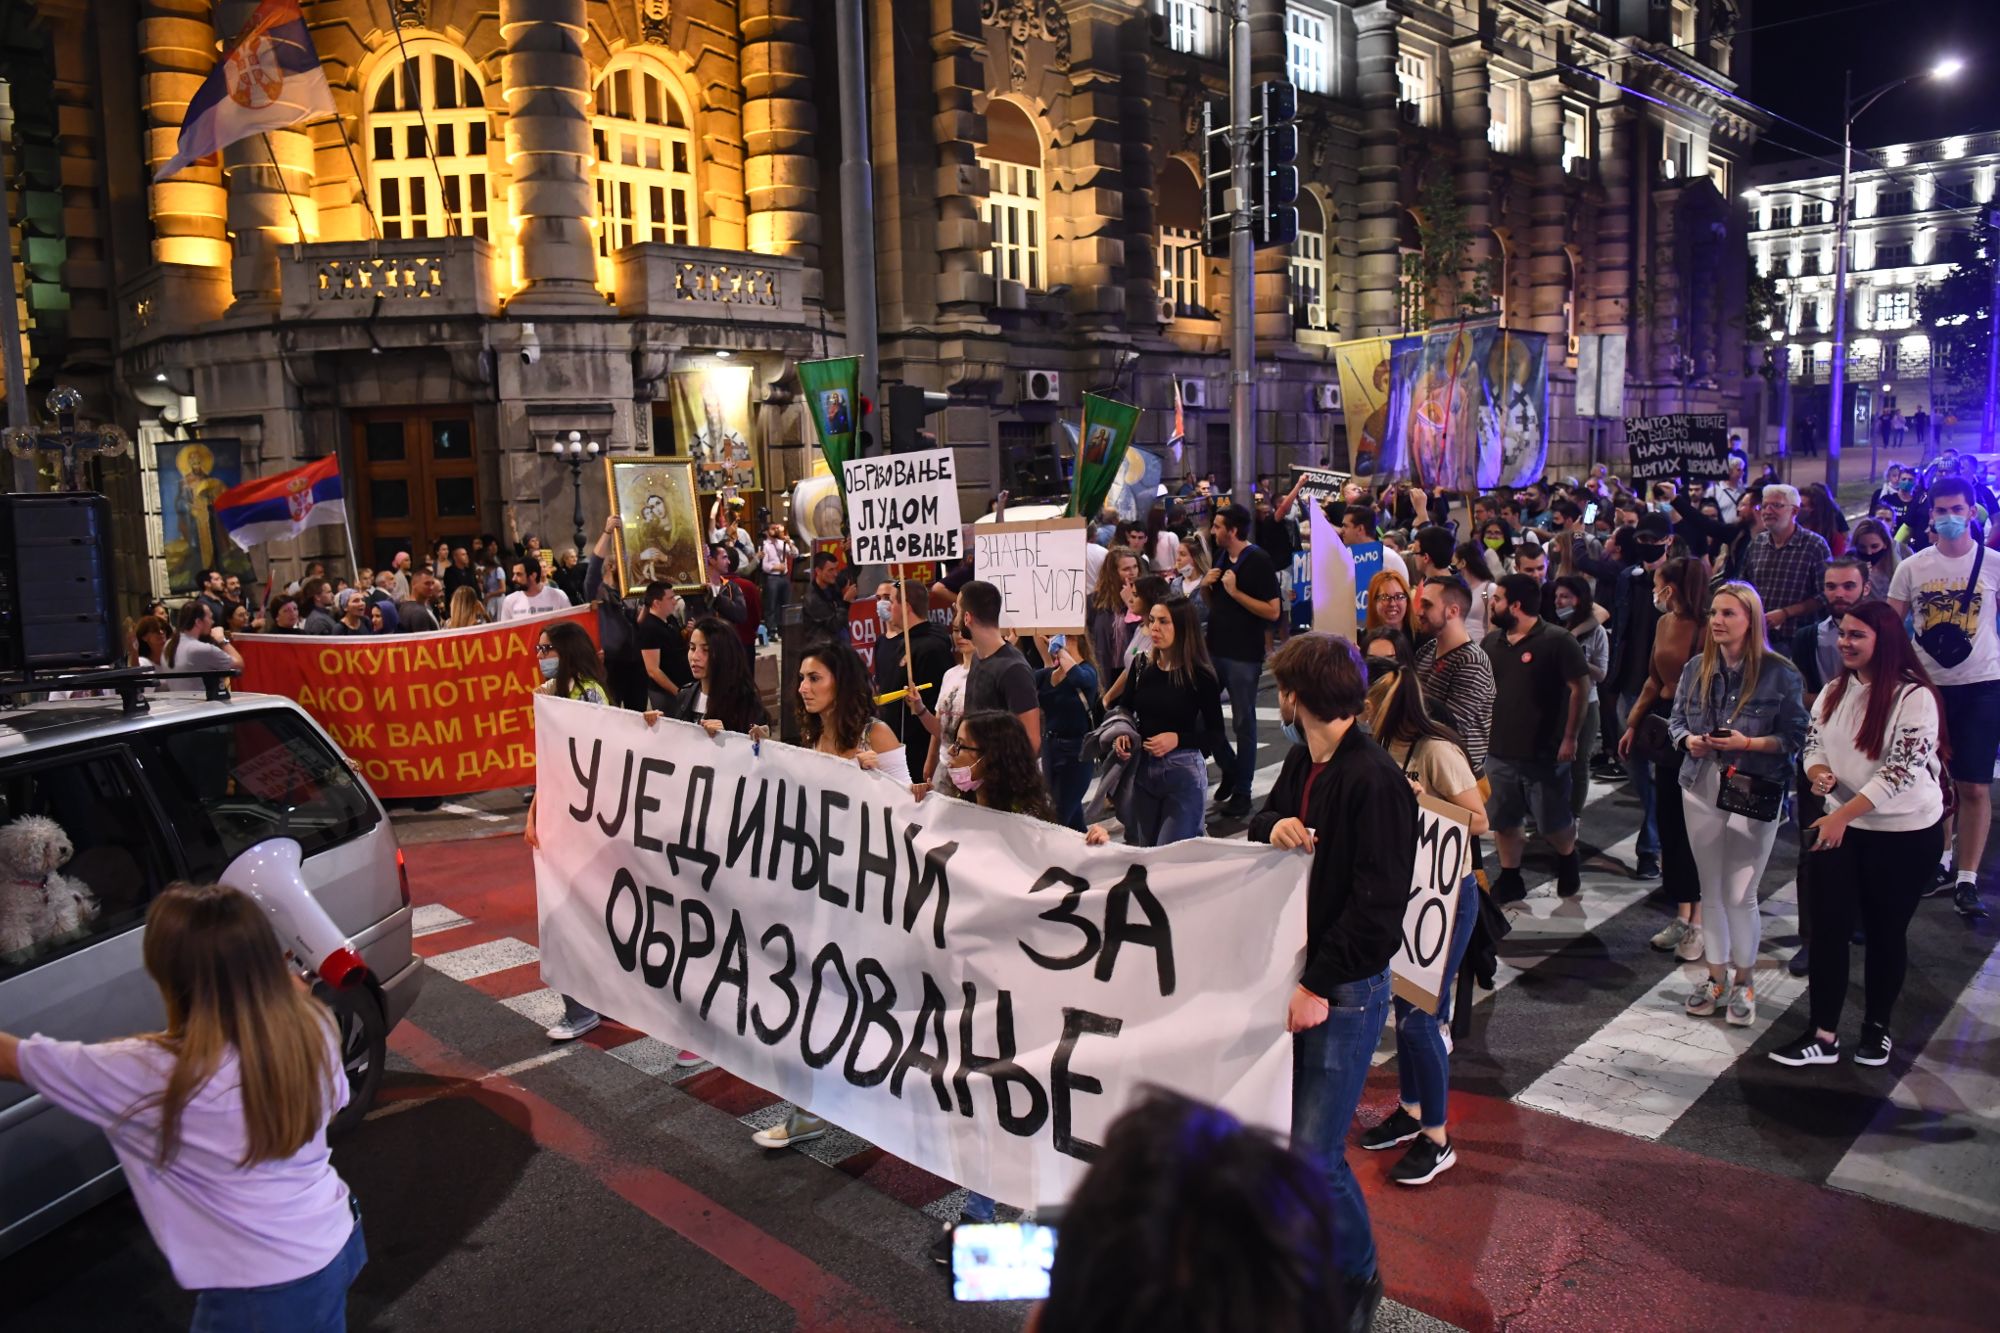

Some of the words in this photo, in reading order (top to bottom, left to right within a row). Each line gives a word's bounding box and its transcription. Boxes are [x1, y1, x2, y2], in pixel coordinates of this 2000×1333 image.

[1625, 416, 1671, 433] ЗАШТО
[1627, 431, 1646, 446] ДА
[1636, 440, 1715, 458] НАУЧНИЦИ
[845, 456, 952, 494] ОБРАЗОВАЊЕ
[858, 495, 939, 532] ЛУДОМ
[856, 529, 958, 562] РАДОВАЊЕ
[978, 531, 1051, 570] ЗНАЊЕ
[1032, 568, 1084, 619] МОЋ
[319, 632, 529, 675] ОКУПАЦИЈА
[299, 684, 364, 712] АКО
[374, 686, 397, 711] И
[387, 719, 463, 748] ВАМ
[568, 737, 960, 949] УЈЕДИЊЕНИ
[1018, 864, 1176, 996] ЗА
[605, 867, 1123, 1164] ОБРАЗОВАЊЕ
